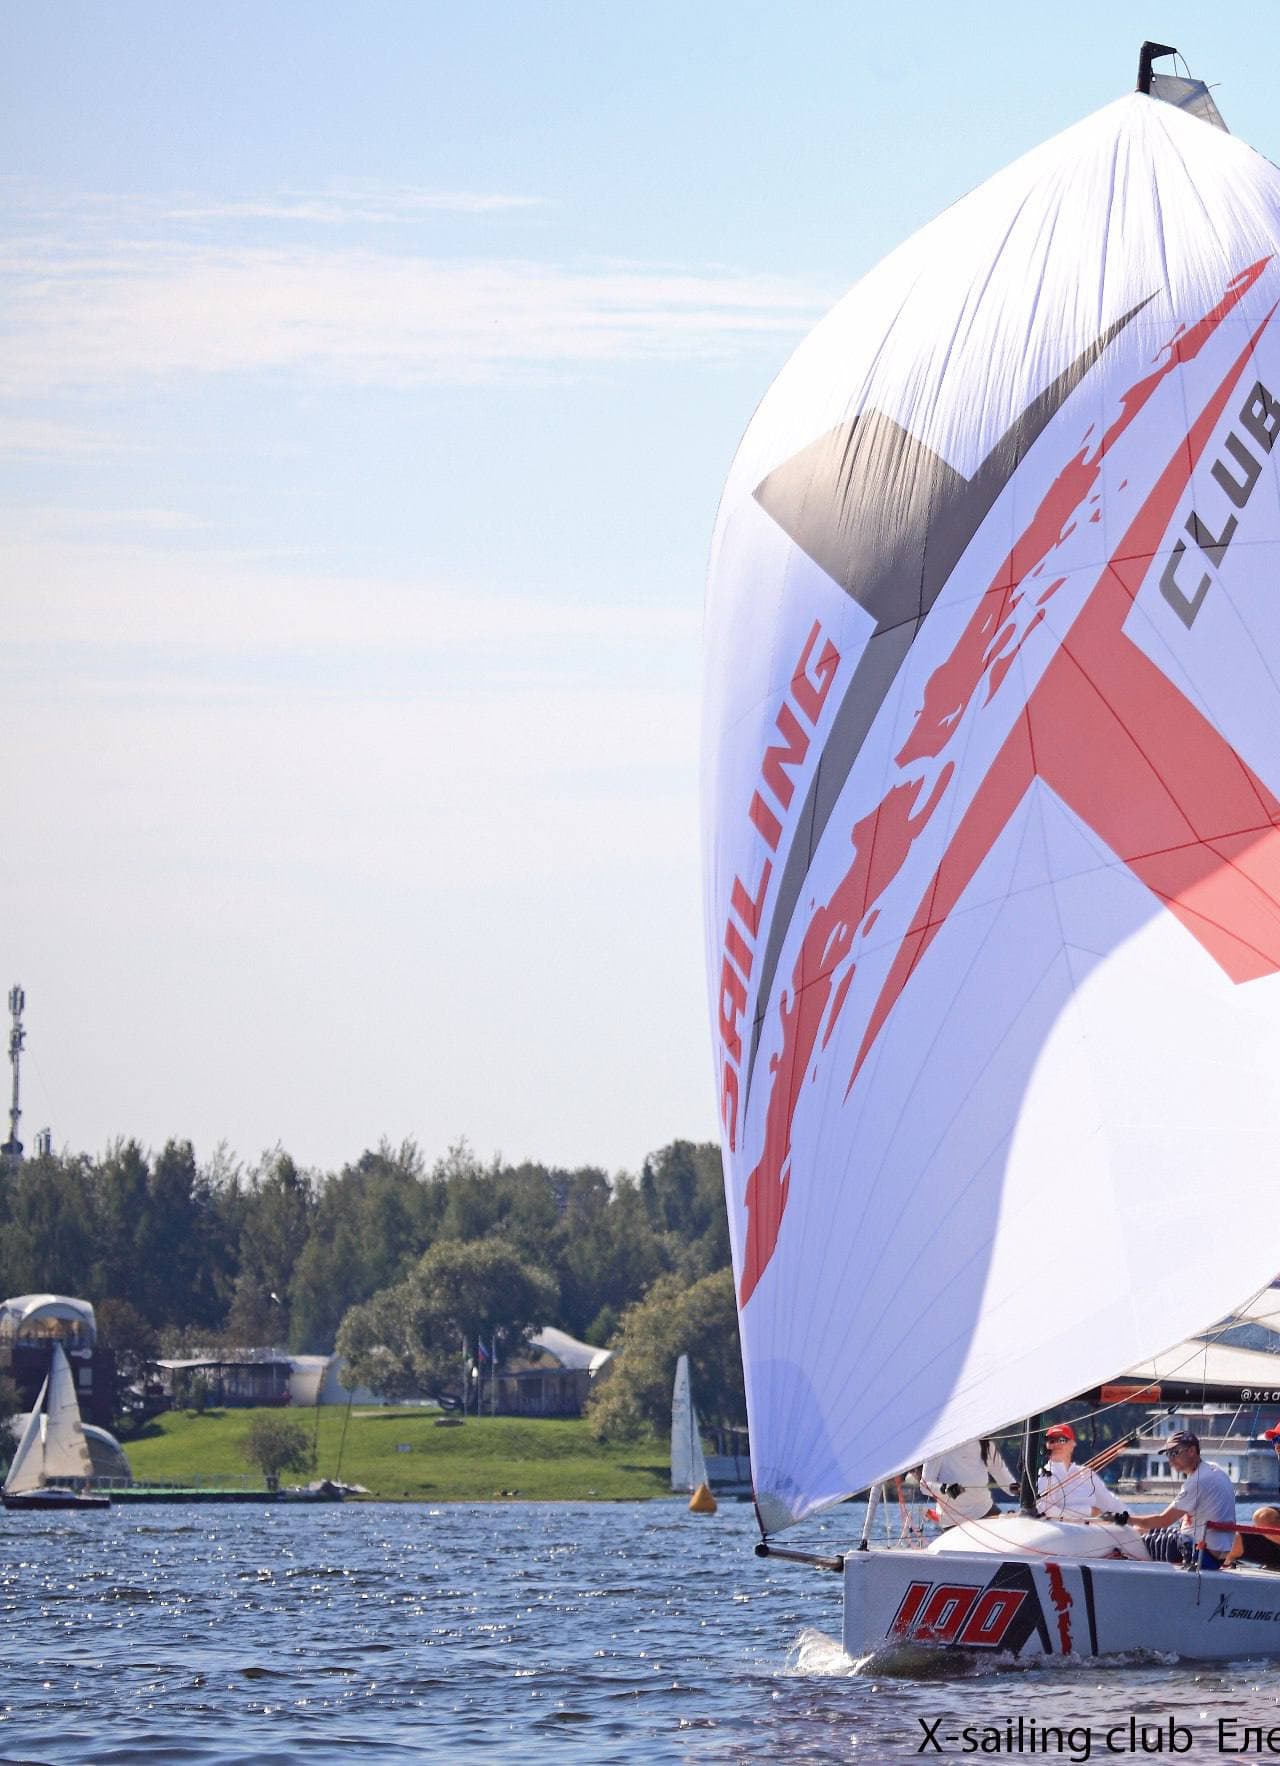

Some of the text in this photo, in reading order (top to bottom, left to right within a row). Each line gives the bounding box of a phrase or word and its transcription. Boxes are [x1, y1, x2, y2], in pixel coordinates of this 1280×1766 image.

[719, 618, 842, 1153] SAILING
[885, 1581, 1028, 1648] 100
[1228, 1608, 1273, 1621] SAILING
